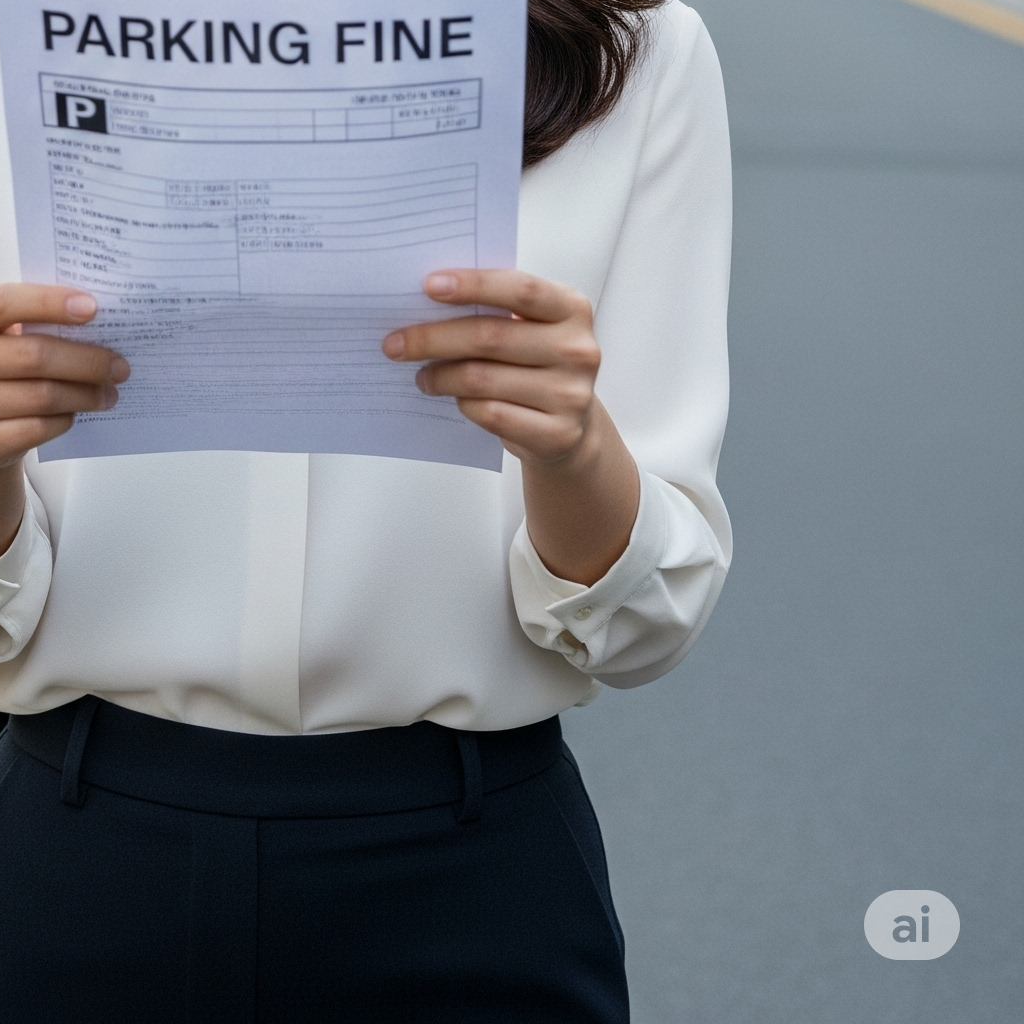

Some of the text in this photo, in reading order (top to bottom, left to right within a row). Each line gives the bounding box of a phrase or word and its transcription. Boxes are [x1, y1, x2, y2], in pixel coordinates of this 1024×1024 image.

[41, 9, 474, 65] PARKING FINE
[65, 96, 97, 128] P
